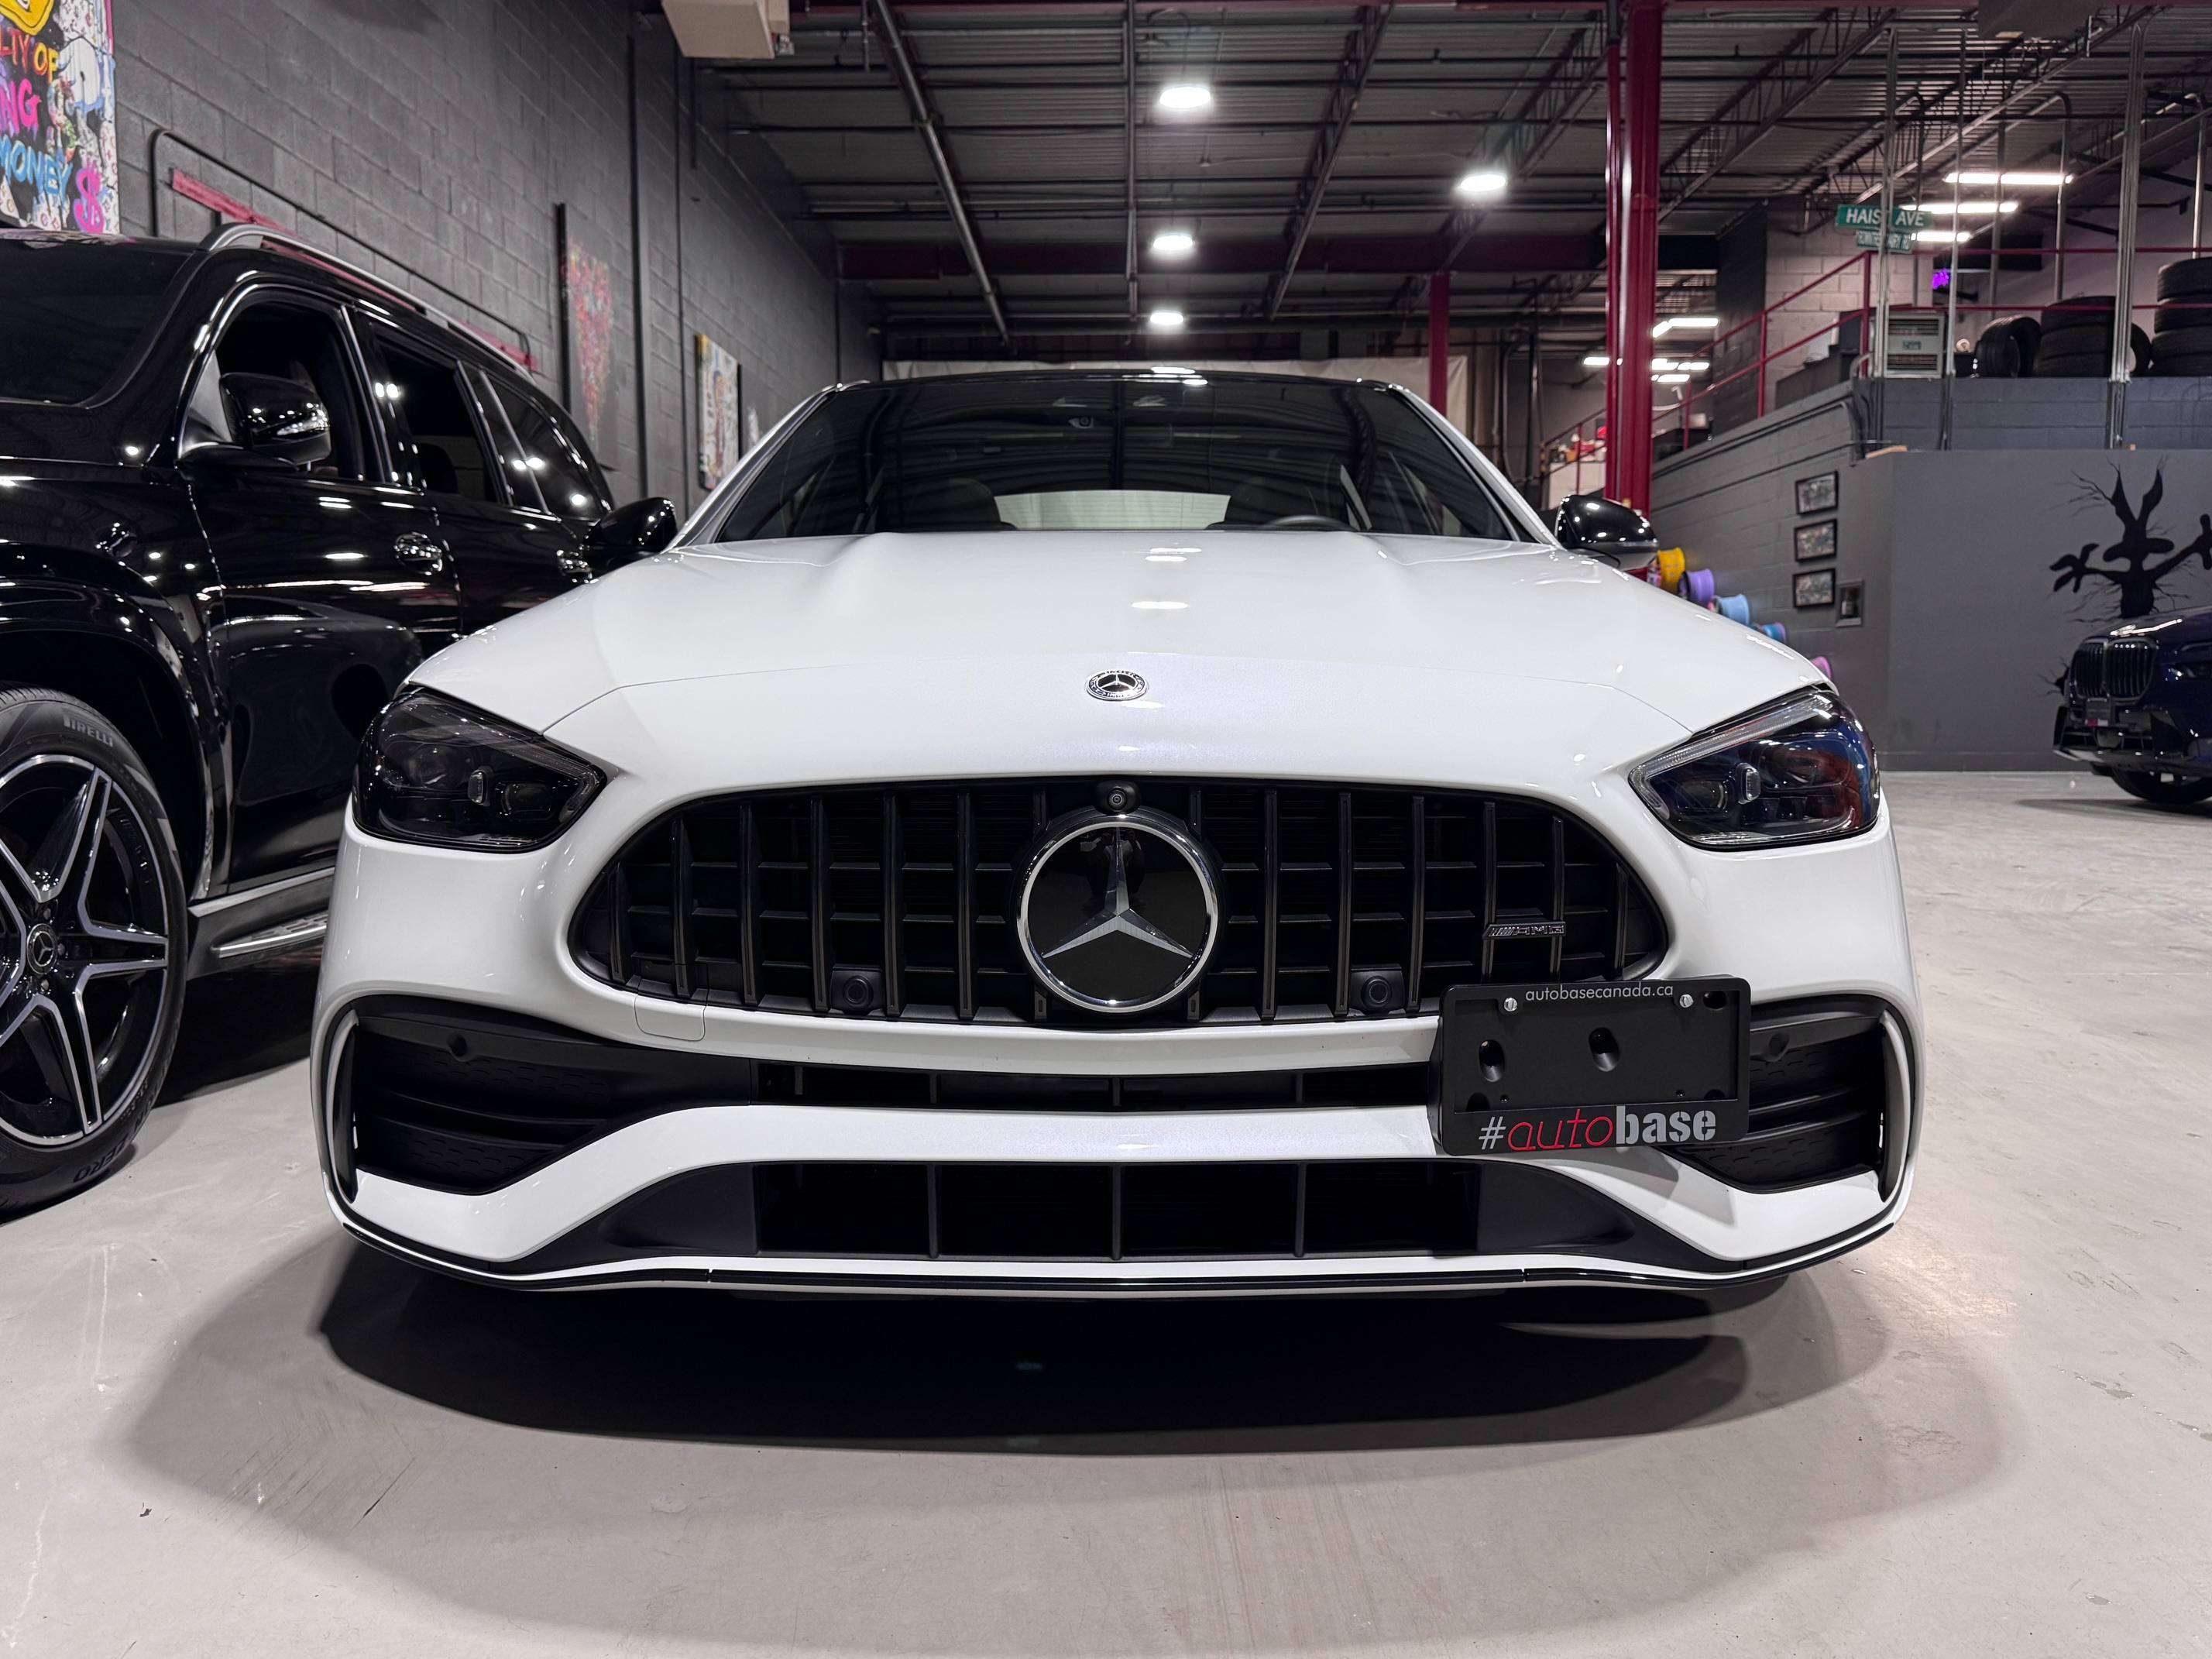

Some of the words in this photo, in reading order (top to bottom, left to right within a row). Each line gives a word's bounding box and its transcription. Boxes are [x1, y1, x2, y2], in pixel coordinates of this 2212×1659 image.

[33, 42, 60, 84] OF
[1846, 208, 1883, 224] HAIS
[1895, 211, 1924, 226] AVE
[1525, 983, 1674, 1001] autobasecanada.ca
[1479, 1105, 1716, 1152] #autobase
